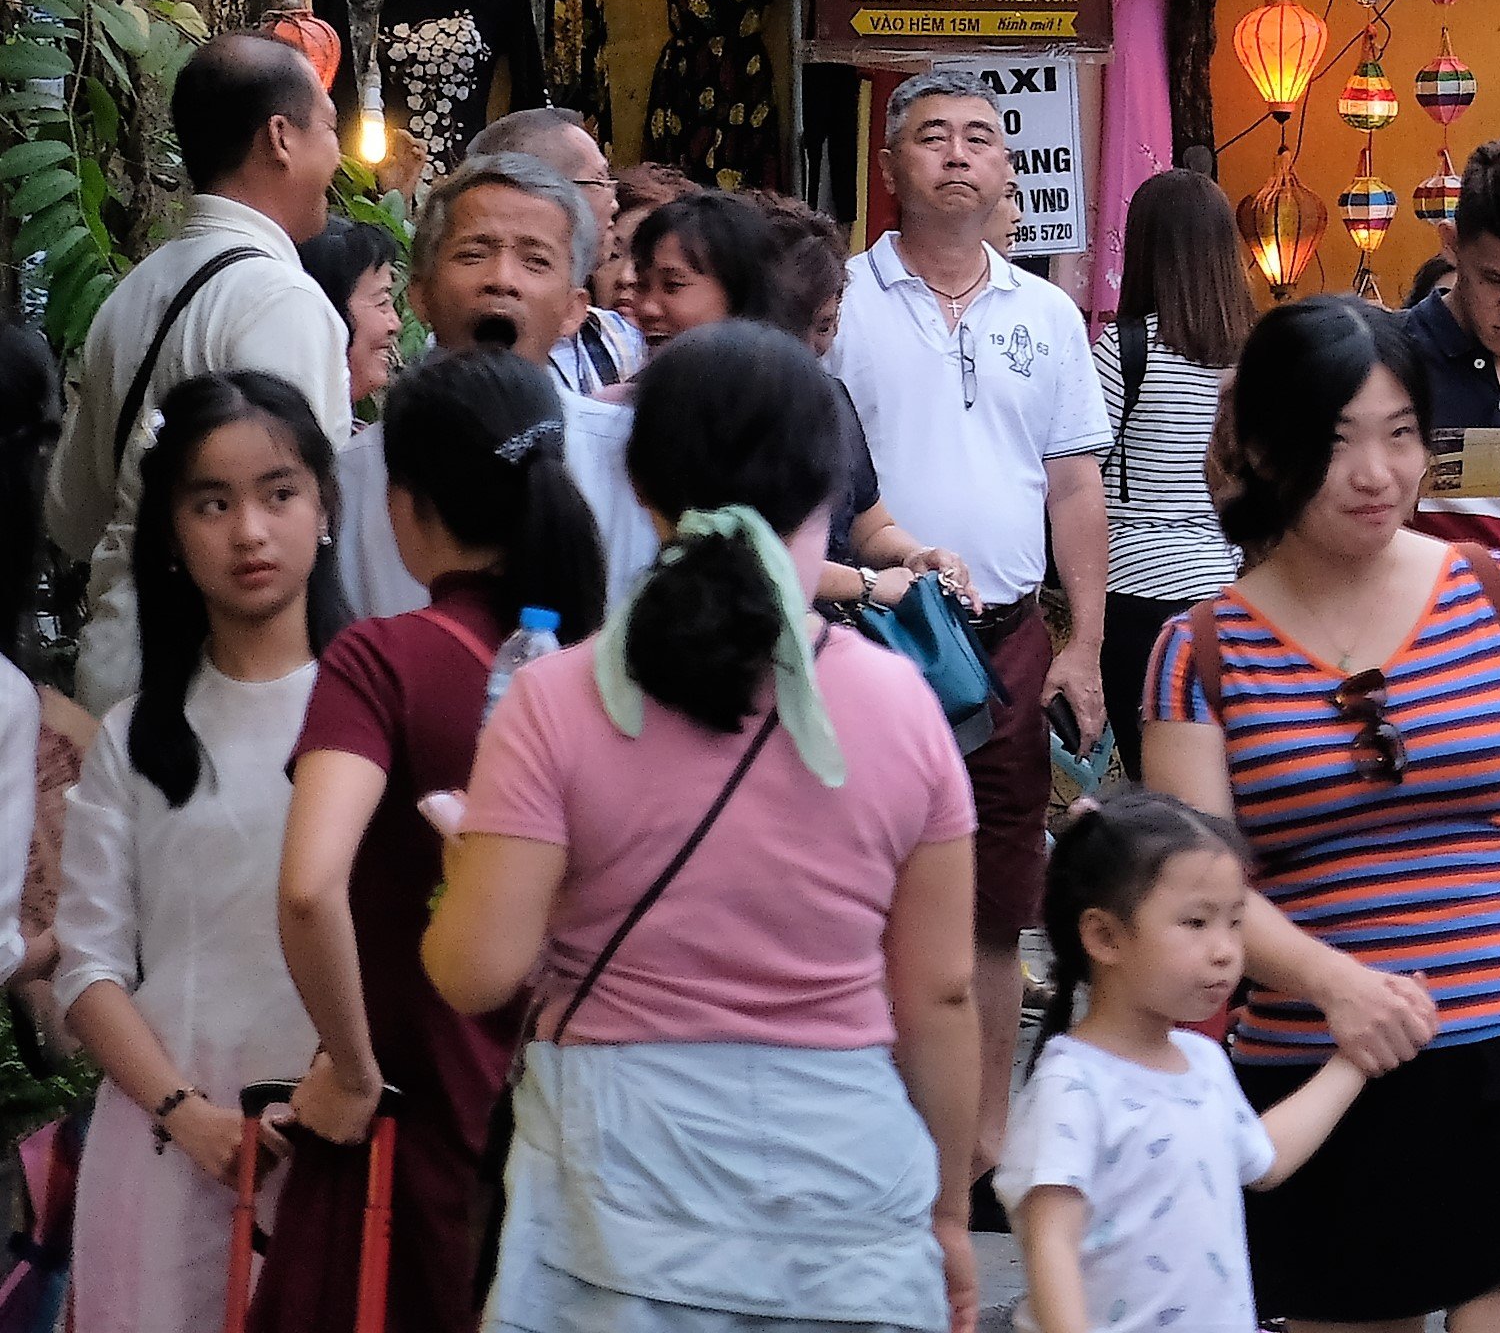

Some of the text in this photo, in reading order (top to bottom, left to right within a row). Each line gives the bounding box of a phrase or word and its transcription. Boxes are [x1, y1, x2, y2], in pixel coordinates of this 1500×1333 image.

[870, 15, 904, 31] VÀO
[950, 18, 980, 32] 15M
[979, 67, 1057, 94] AXI
[1003, 109, 1021, 134] O
[1013, 147, 1071, 174] ANG
[1031, 188, 1069, 213] VND
[1041, 223, 1072, 240] 5720
[990, 333, 1048, 356] 19 63
